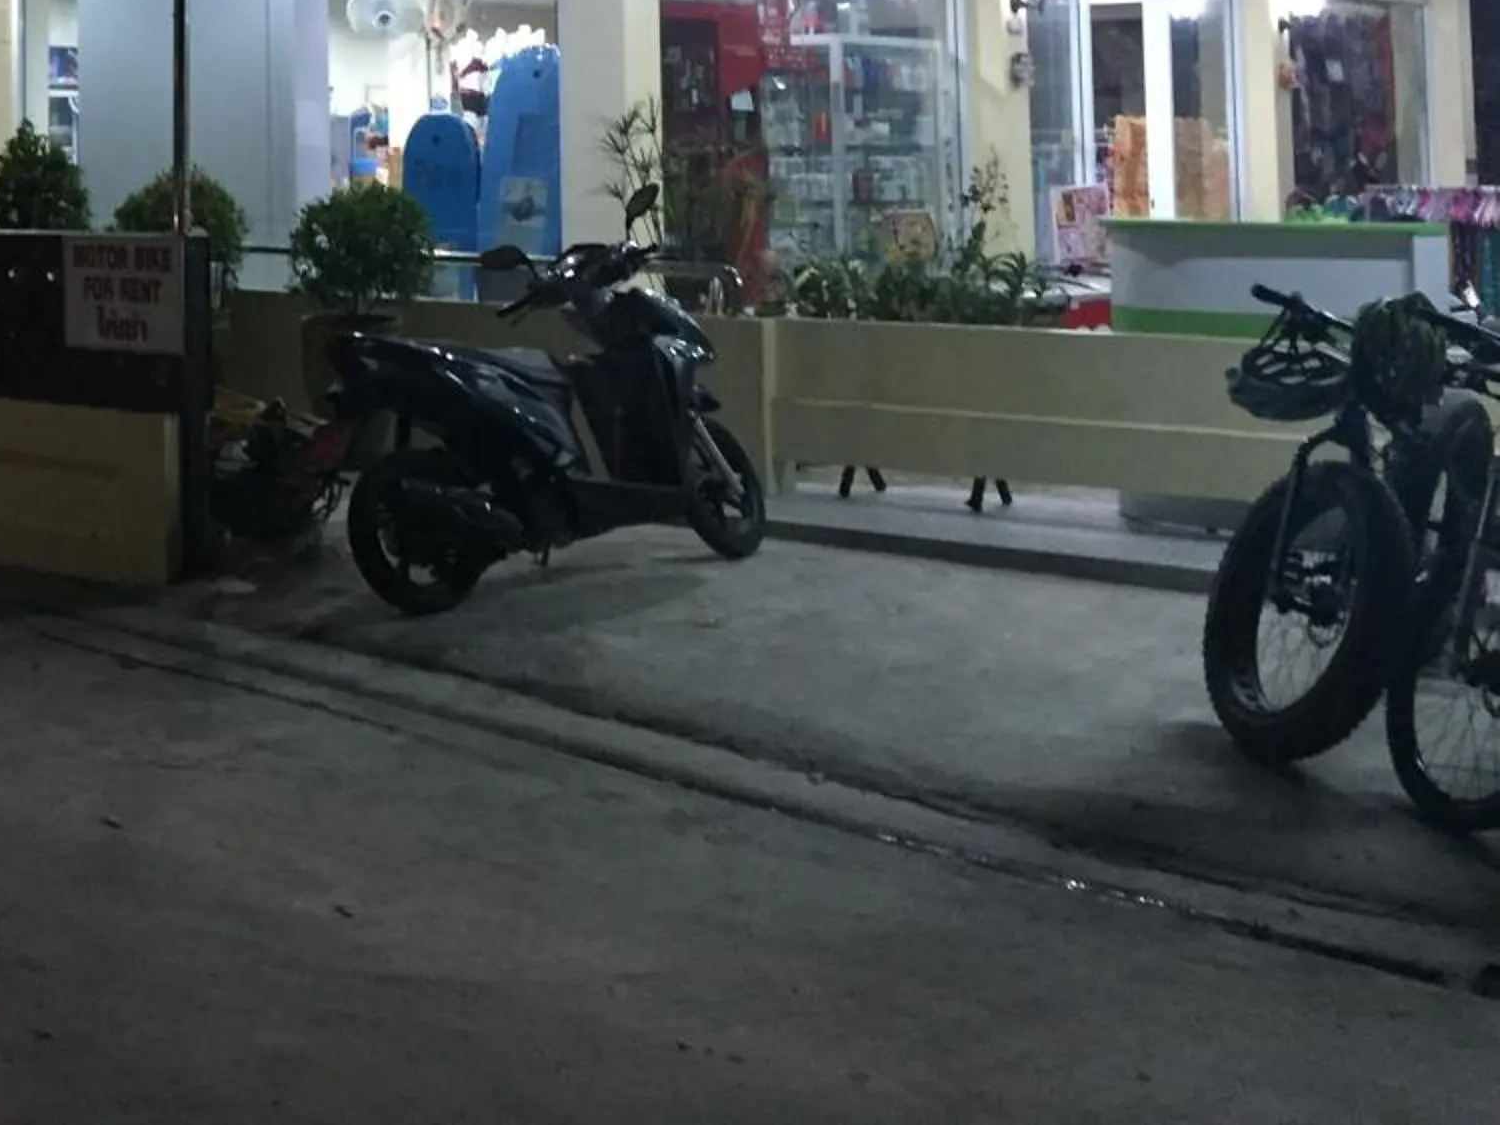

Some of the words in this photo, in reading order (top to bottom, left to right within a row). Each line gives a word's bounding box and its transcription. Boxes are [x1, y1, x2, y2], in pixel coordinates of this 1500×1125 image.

[73, 243, 129, 270] MOTOR
[135, 246, 173, 273] BIKE
[83, 276, 114, 301] FOR
[120, 277, 163, 304] RENT
